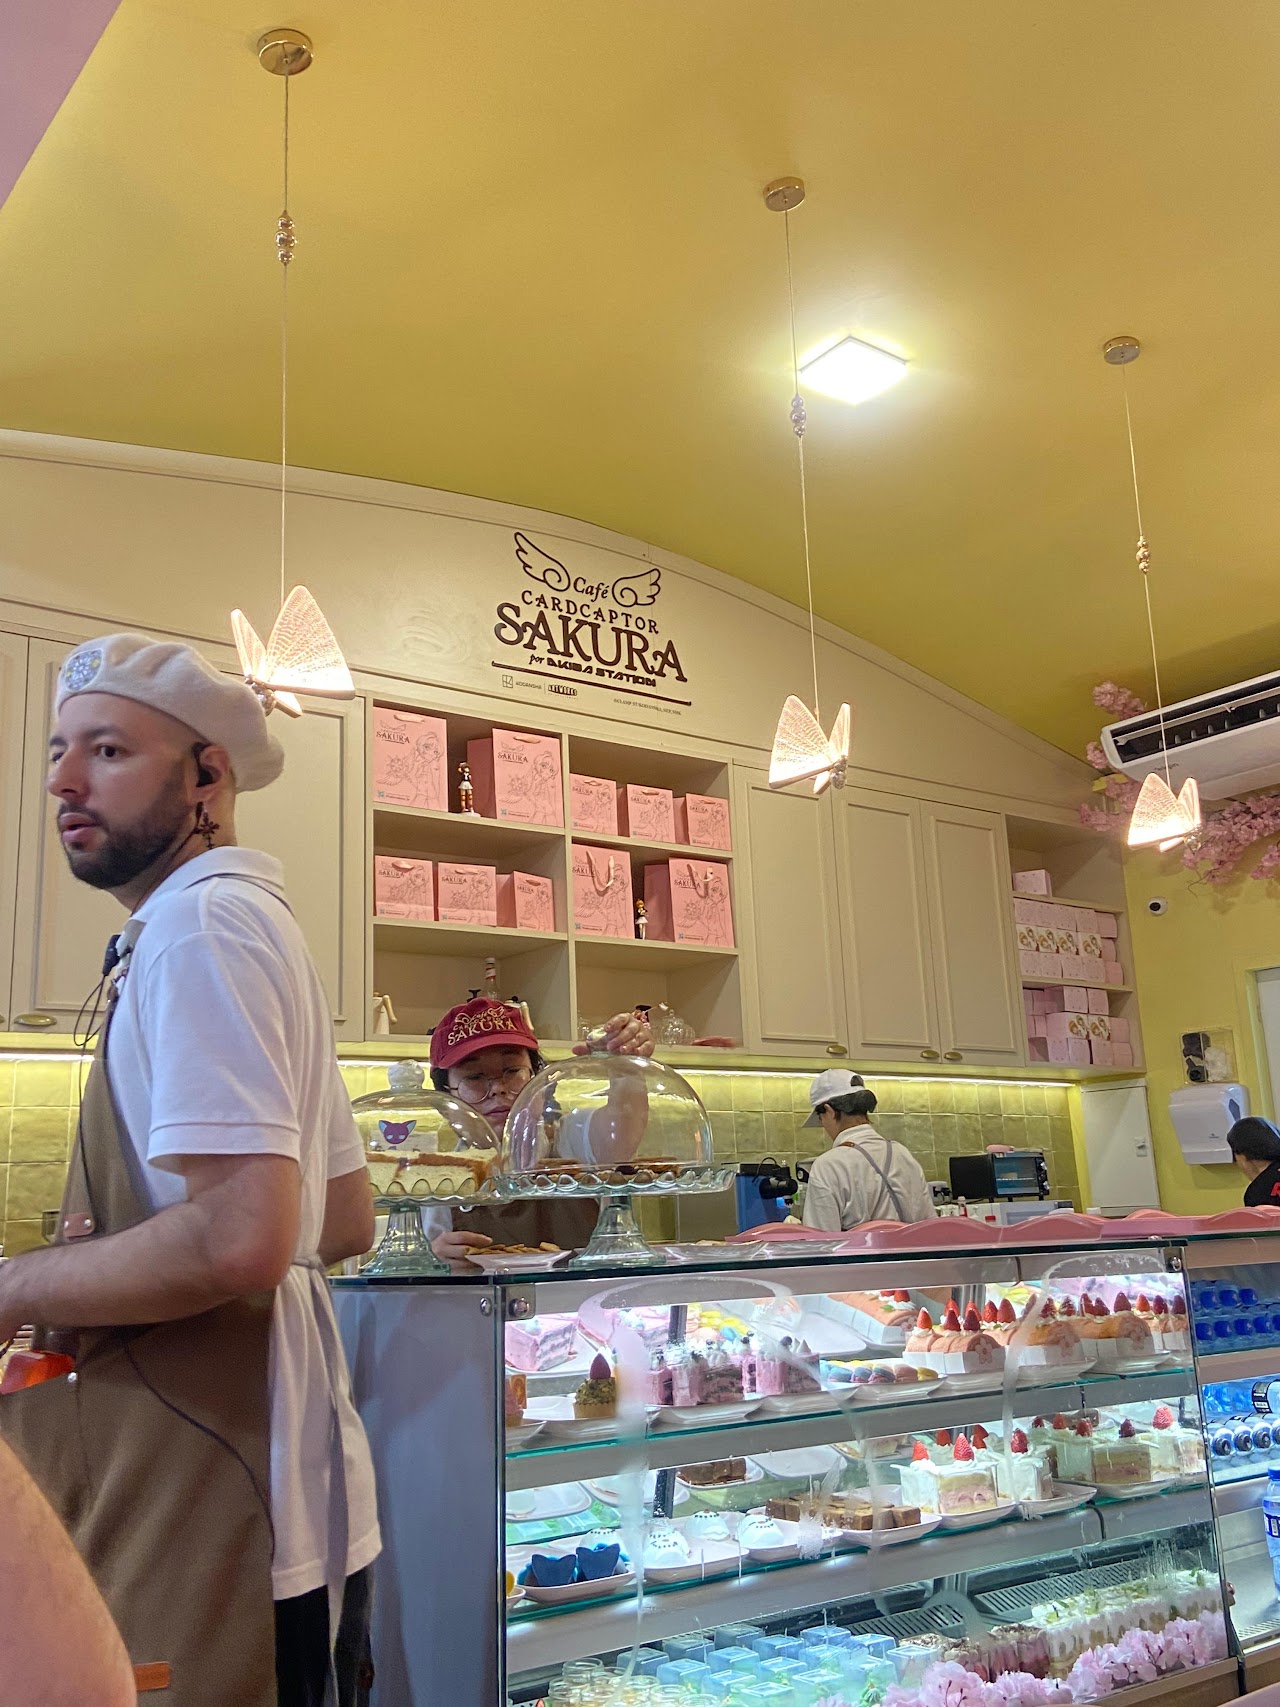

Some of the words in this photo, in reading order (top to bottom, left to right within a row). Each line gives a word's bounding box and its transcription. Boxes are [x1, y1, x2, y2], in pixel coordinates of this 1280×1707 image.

[573, 576, 609, 602] Café
[521, 590, 659, 635] CARDCAPTOR
[494, 602, 688, 683] SAKURA
[528, 654, 545, 665] por
[546, 657, 593, 674] AKIBA
[595, 667, 657, 687] STATION
[376, 730, 410, 744] SAKURA
[497, 751, 528, 763] SAKURA
[441, 876, 468, 885] SAKURA
[447, 1017, 518, 1046] SAKURA
